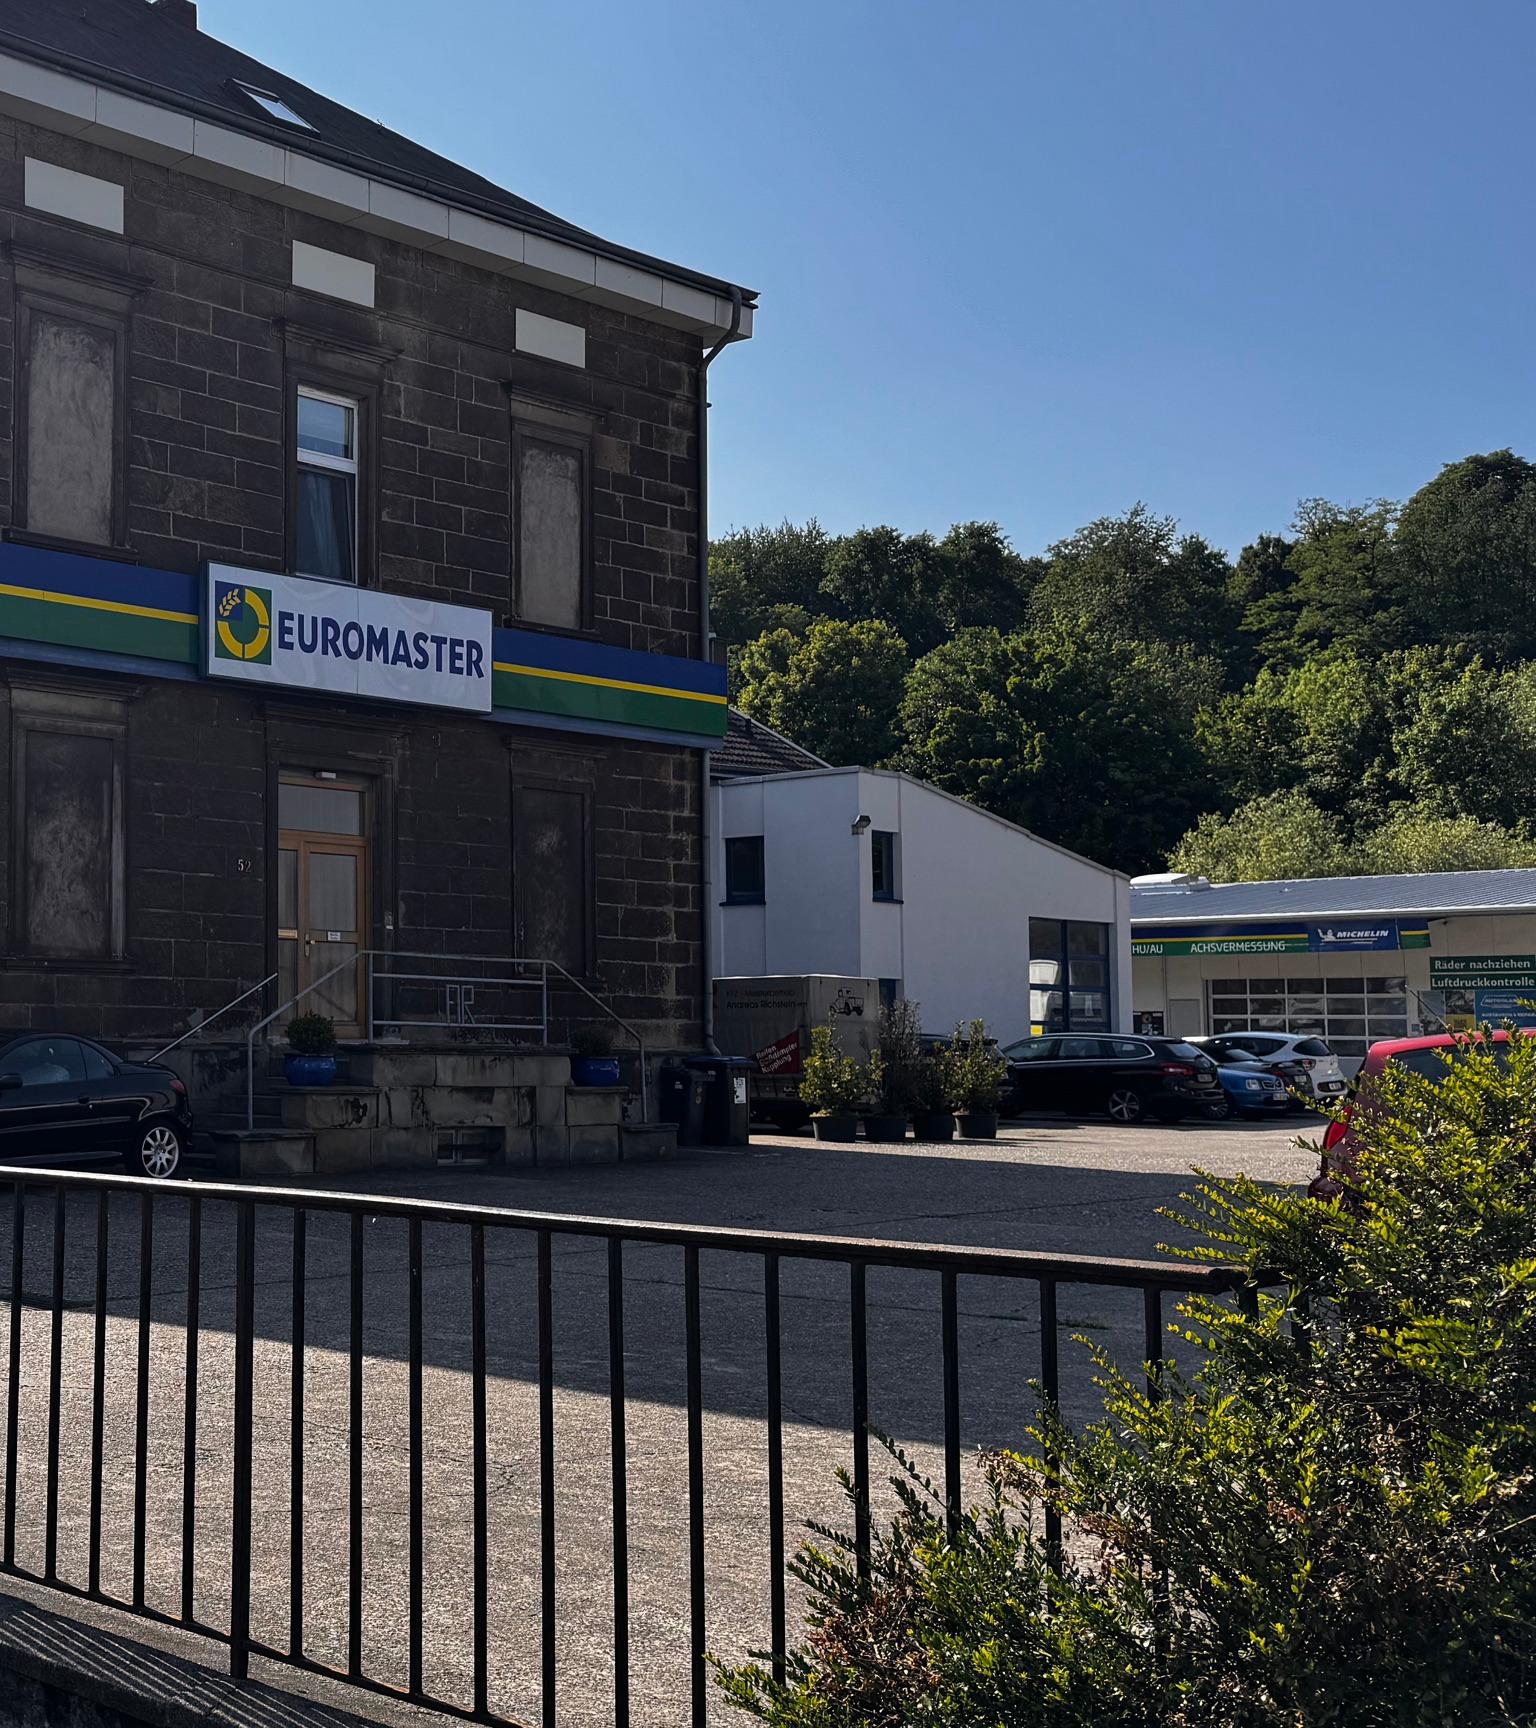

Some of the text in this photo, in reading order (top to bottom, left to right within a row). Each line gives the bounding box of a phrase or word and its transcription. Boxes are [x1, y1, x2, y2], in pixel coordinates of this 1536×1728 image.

[277, 610, 484, 679] EUROMASTER
[1336, 930, 1389, 938] MICHELIN
[1132, 940, 1286, 954] HU/AU ACHSVERMESSUNG
[1435, 959, 1531, 970] Räder nachziehen
[1432, 976, 1535, 988] Luftdruckkontrolle
